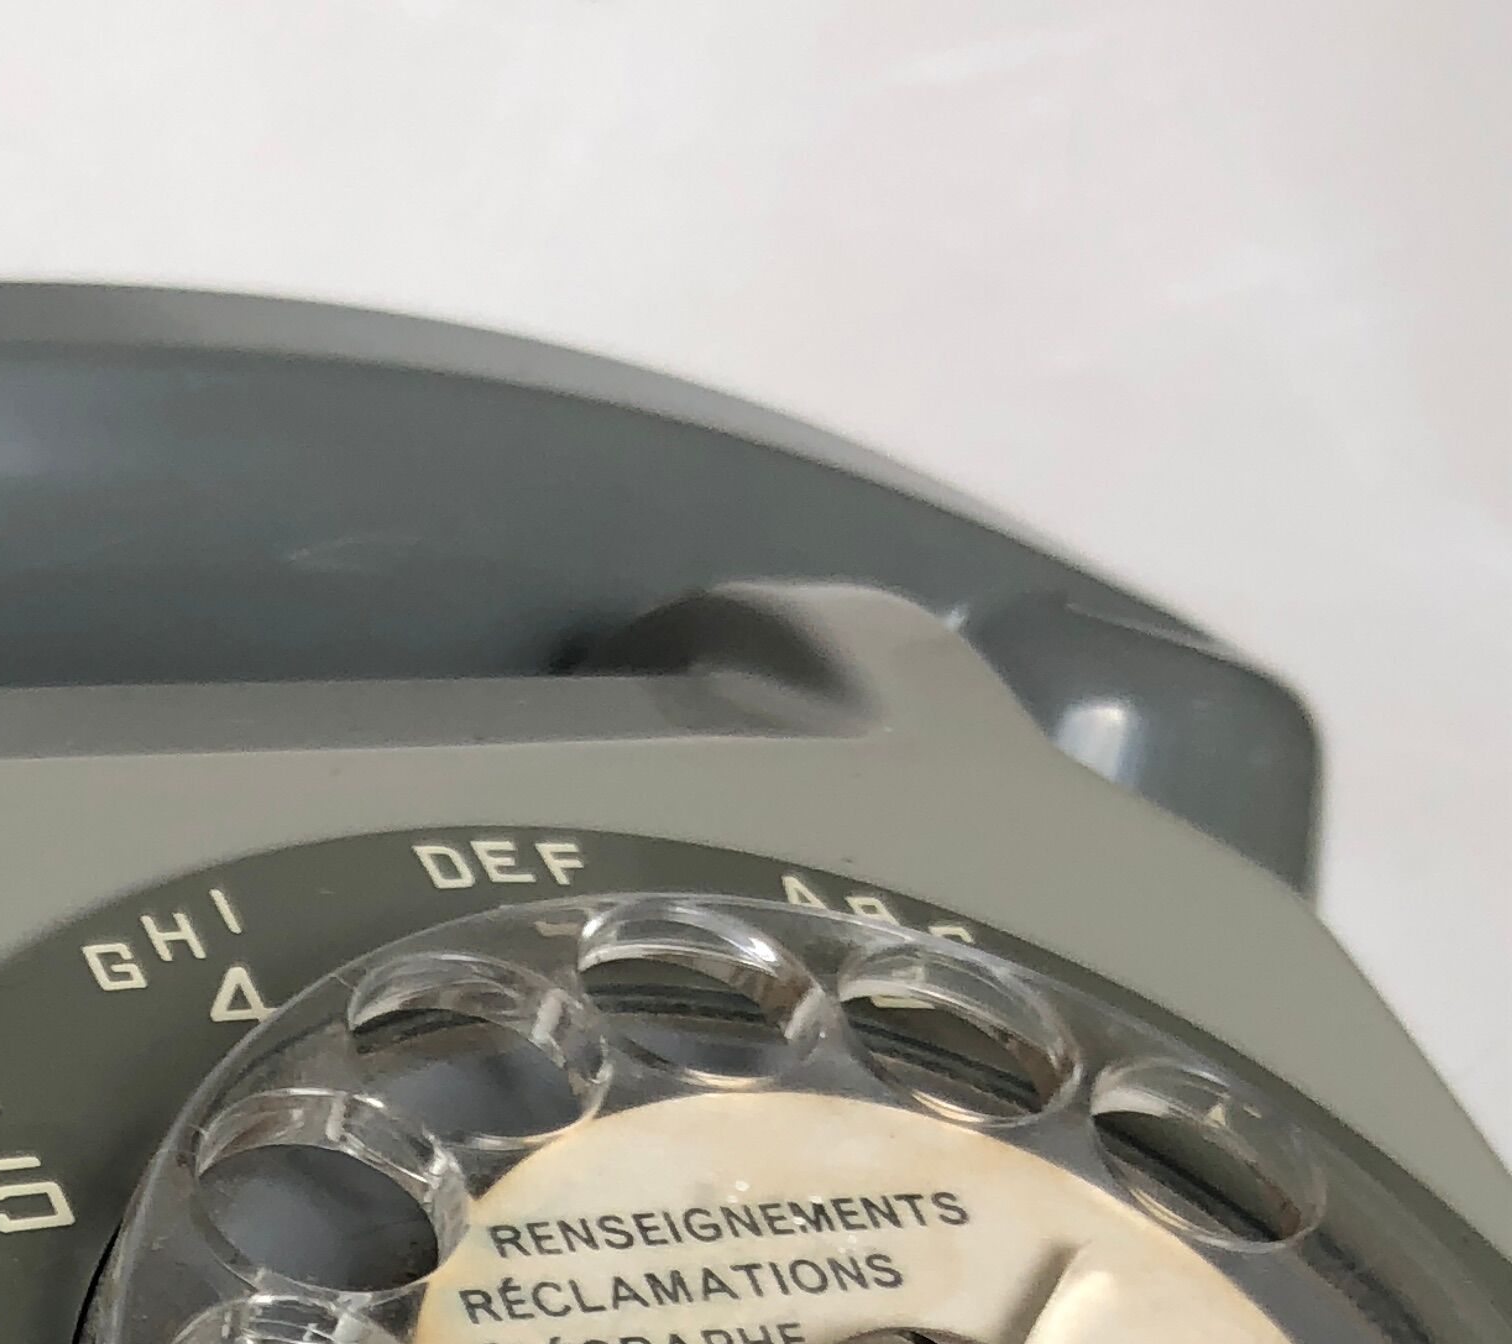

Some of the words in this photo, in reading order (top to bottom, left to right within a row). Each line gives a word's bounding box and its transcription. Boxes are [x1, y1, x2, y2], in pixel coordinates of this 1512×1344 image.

[209, 965, 283, 1023] 4
[489, 1190, 971, 1259] RENSEIGNEMENTS
[458, 1253, 905, 1326] RÉCLAMATIONS
